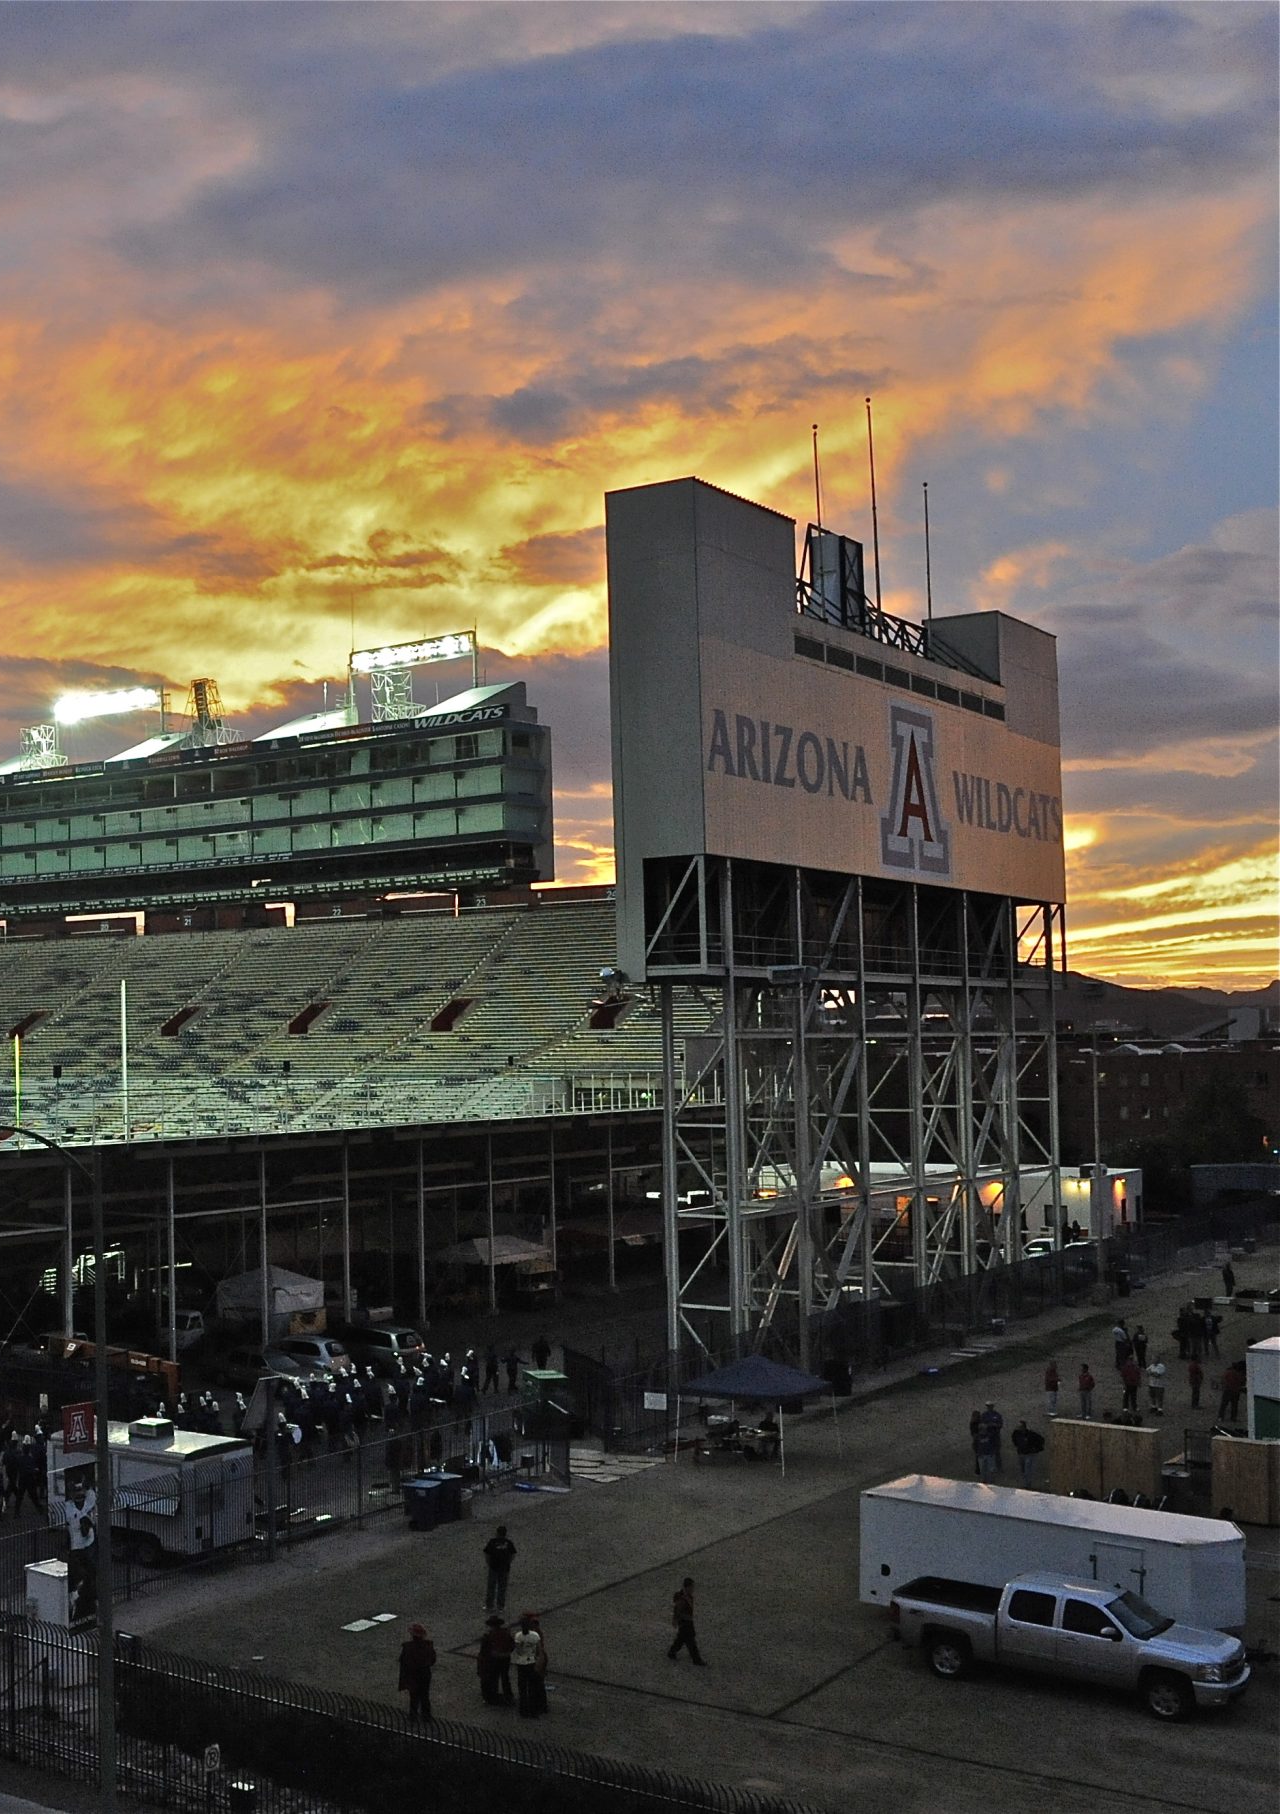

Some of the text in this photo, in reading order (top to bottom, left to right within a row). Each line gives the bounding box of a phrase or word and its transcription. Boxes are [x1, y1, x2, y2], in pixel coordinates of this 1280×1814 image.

[414, 706, 505, 729] WILDCATS
[707, 702, 1062, 876] ARIZONA A WILDCATS
[332, 908, 341, 916] 22
[476, 899, 486, 907] 23
[67, 1411, 89, 1444] A
